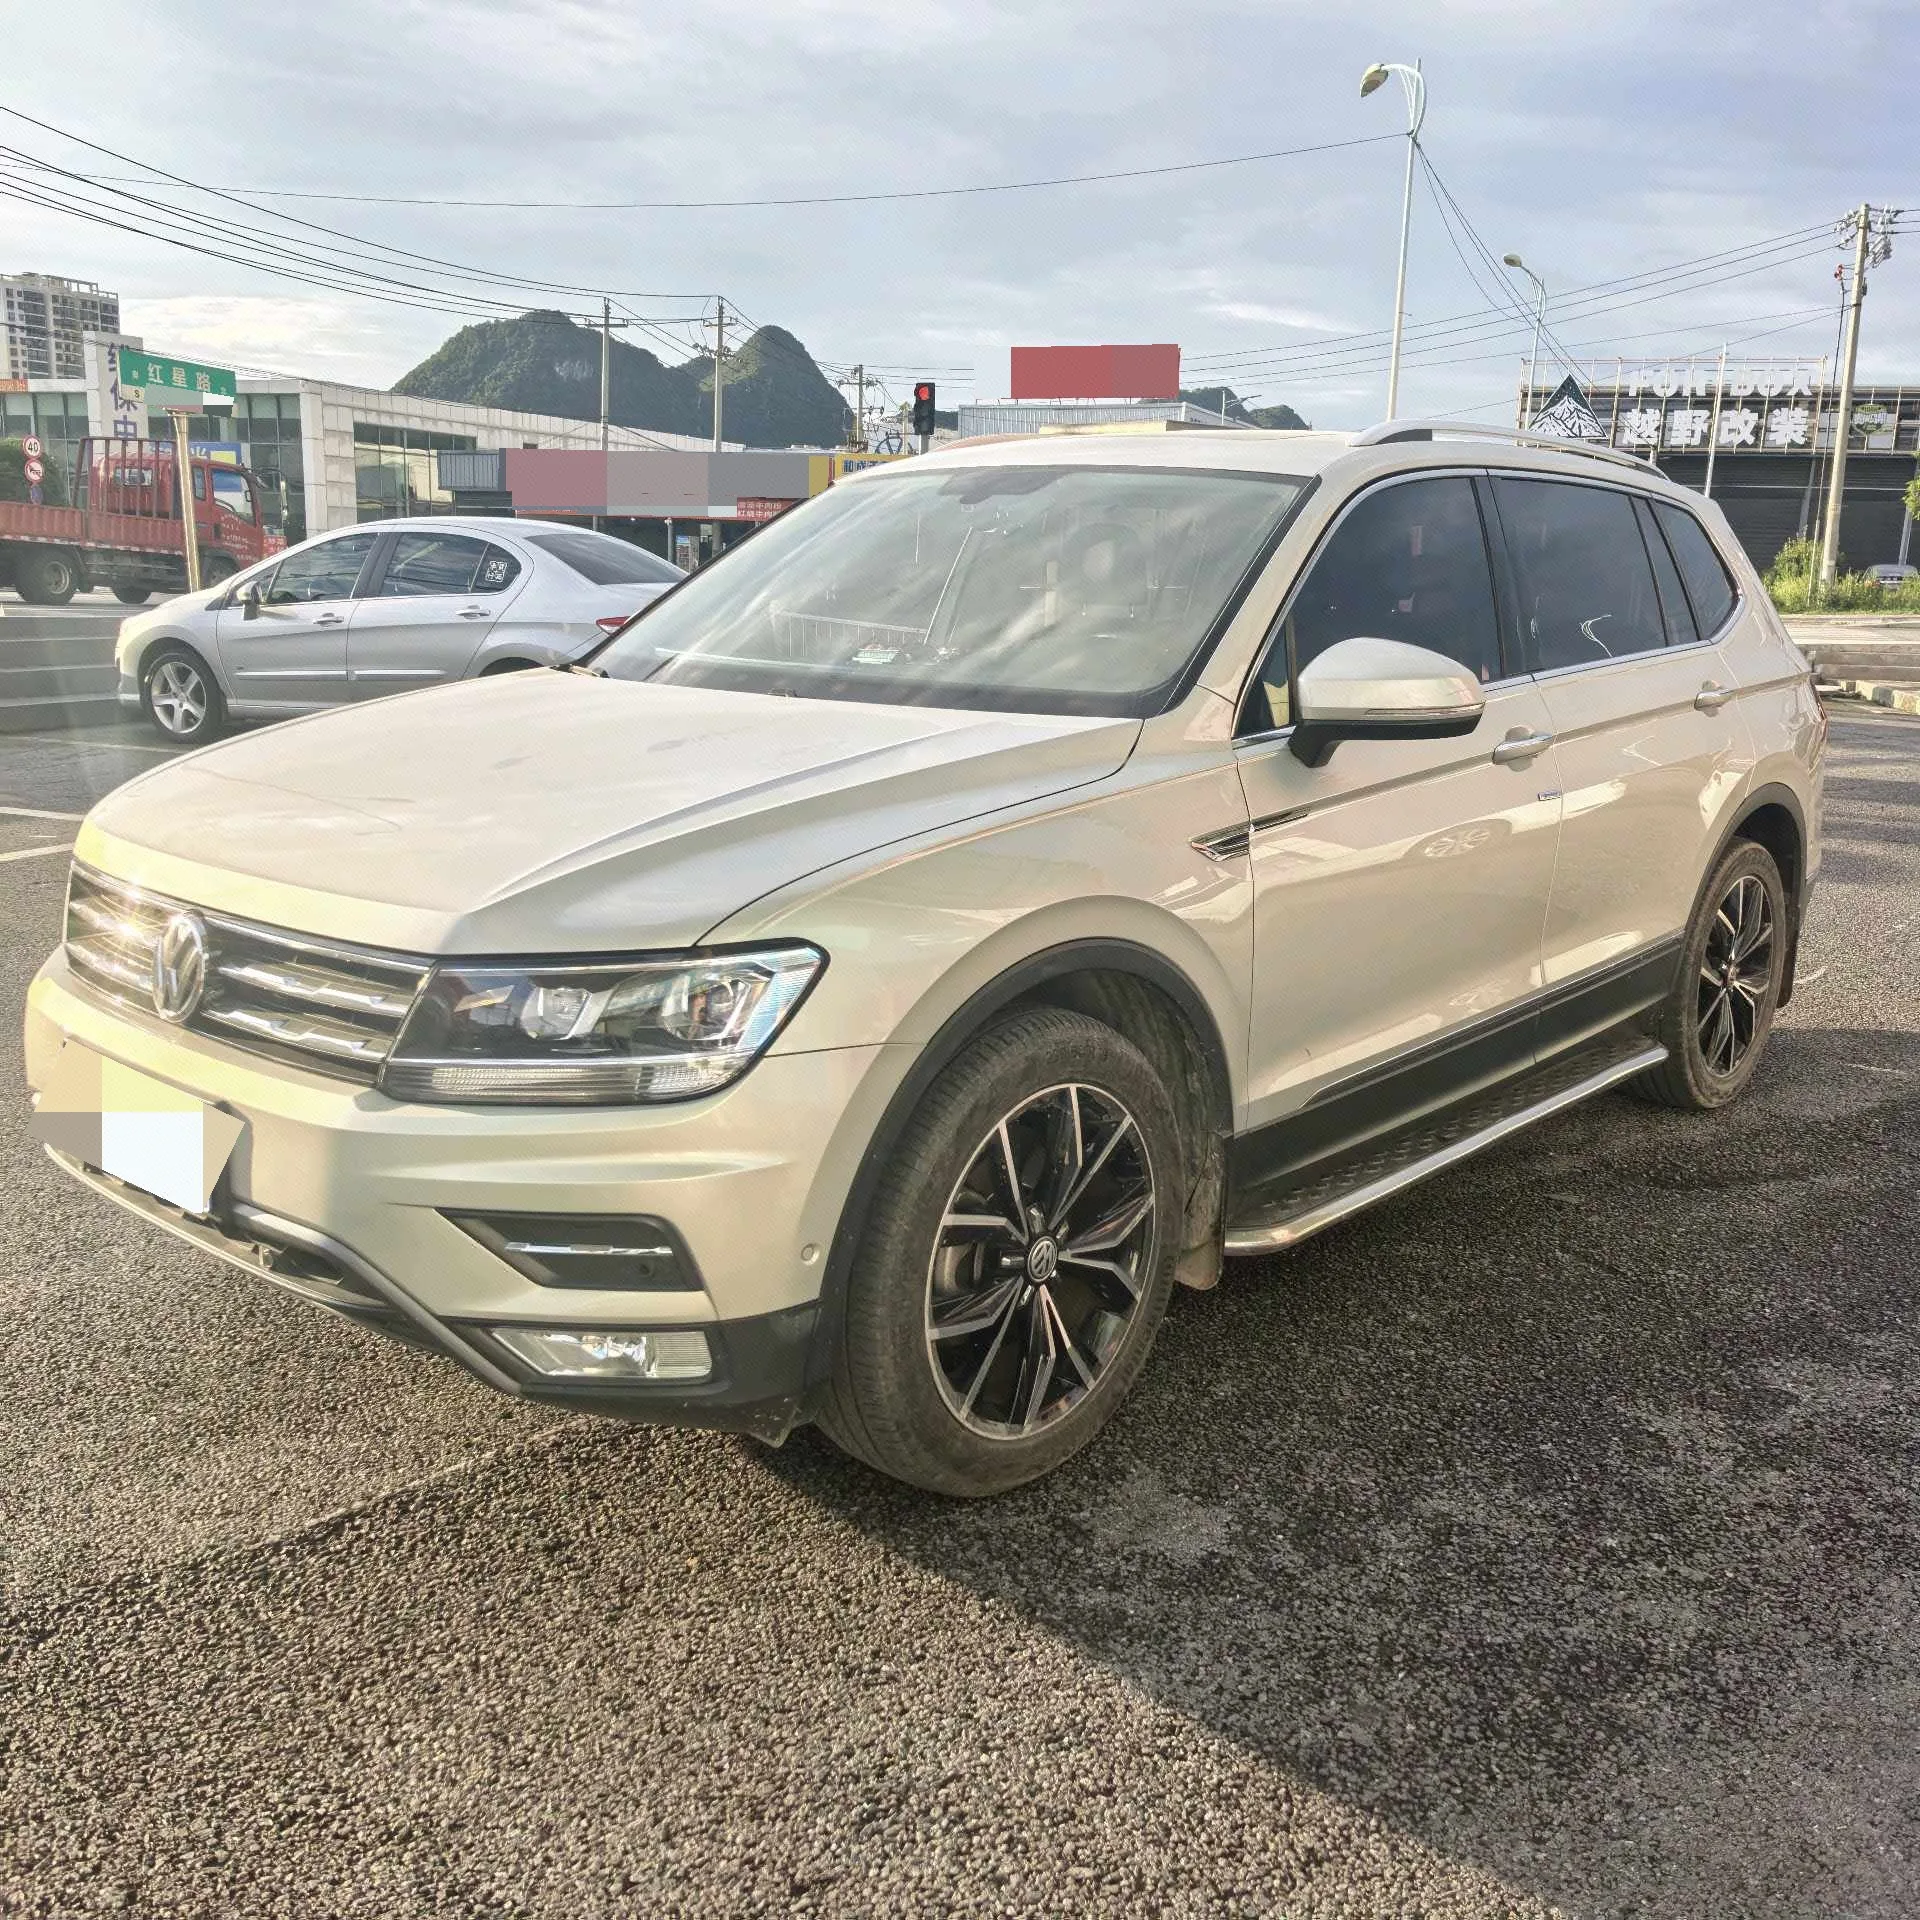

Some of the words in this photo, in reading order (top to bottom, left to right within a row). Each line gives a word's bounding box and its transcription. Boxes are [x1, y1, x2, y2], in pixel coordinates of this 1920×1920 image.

[147, 362, 212, 392] 红星路
[1622, 408, 1809, 445] 越野改装
[27, 442, 38, 454] 40
